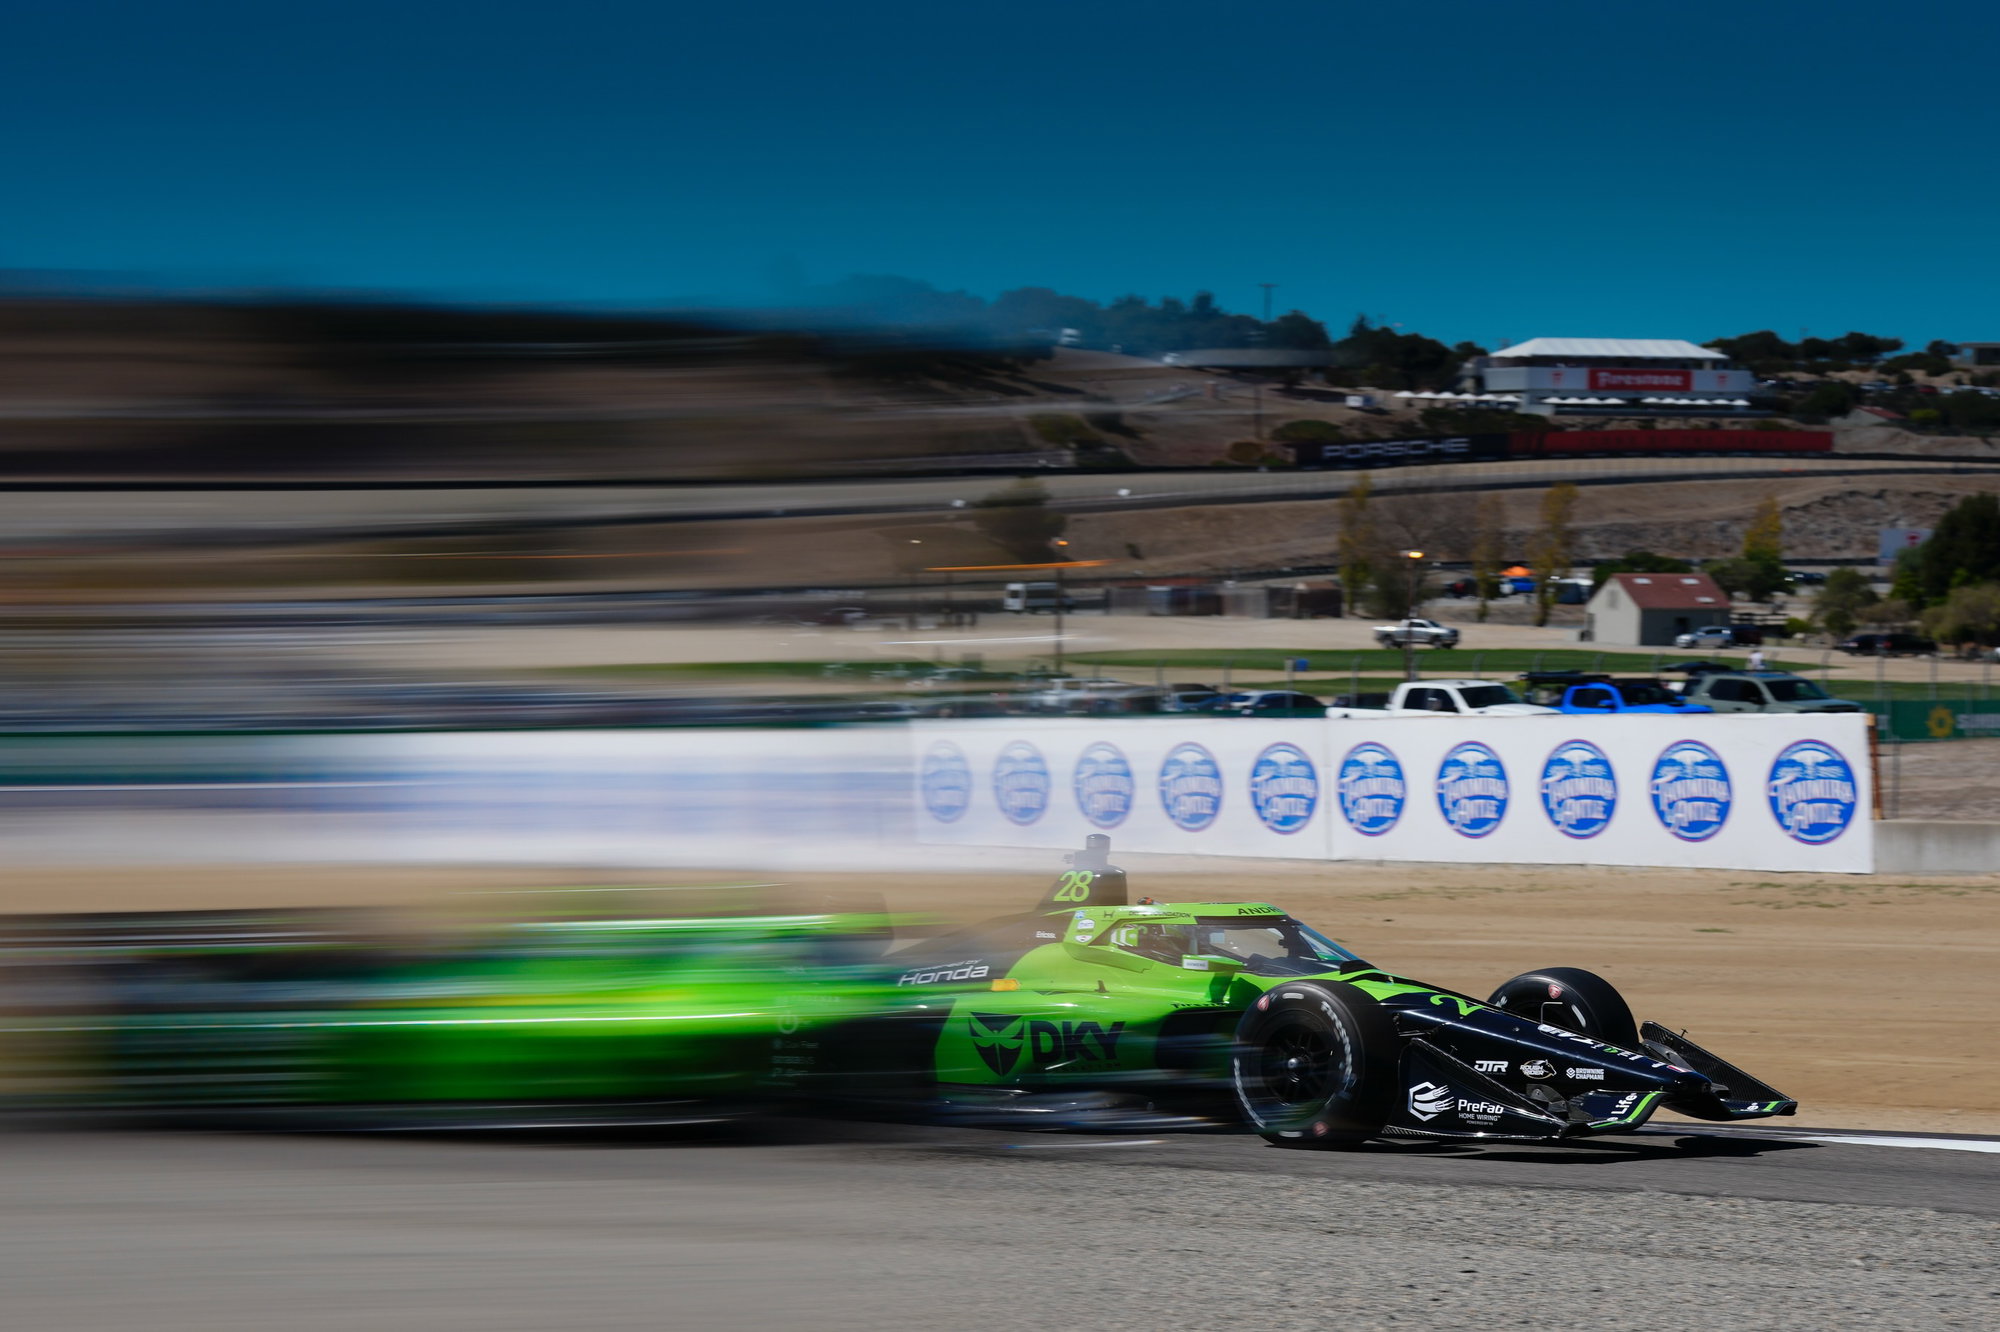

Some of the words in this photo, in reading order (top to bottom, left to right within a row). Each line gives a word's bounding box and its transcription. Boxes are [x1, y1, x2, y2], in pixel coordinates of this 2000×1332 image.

[1322, 438, 1471, 458] PORSCHE
[1052, 870, 1094, 902] 28
[897, 965, 989, 987] Honda
[1030, 1021, 1127, 1063] DKY
[1474, 1060, 1509, 1072] JTR
[1457, 1099, 1505, 1114] PreFab
[1458, 1112, 1475, 1120] HOME
